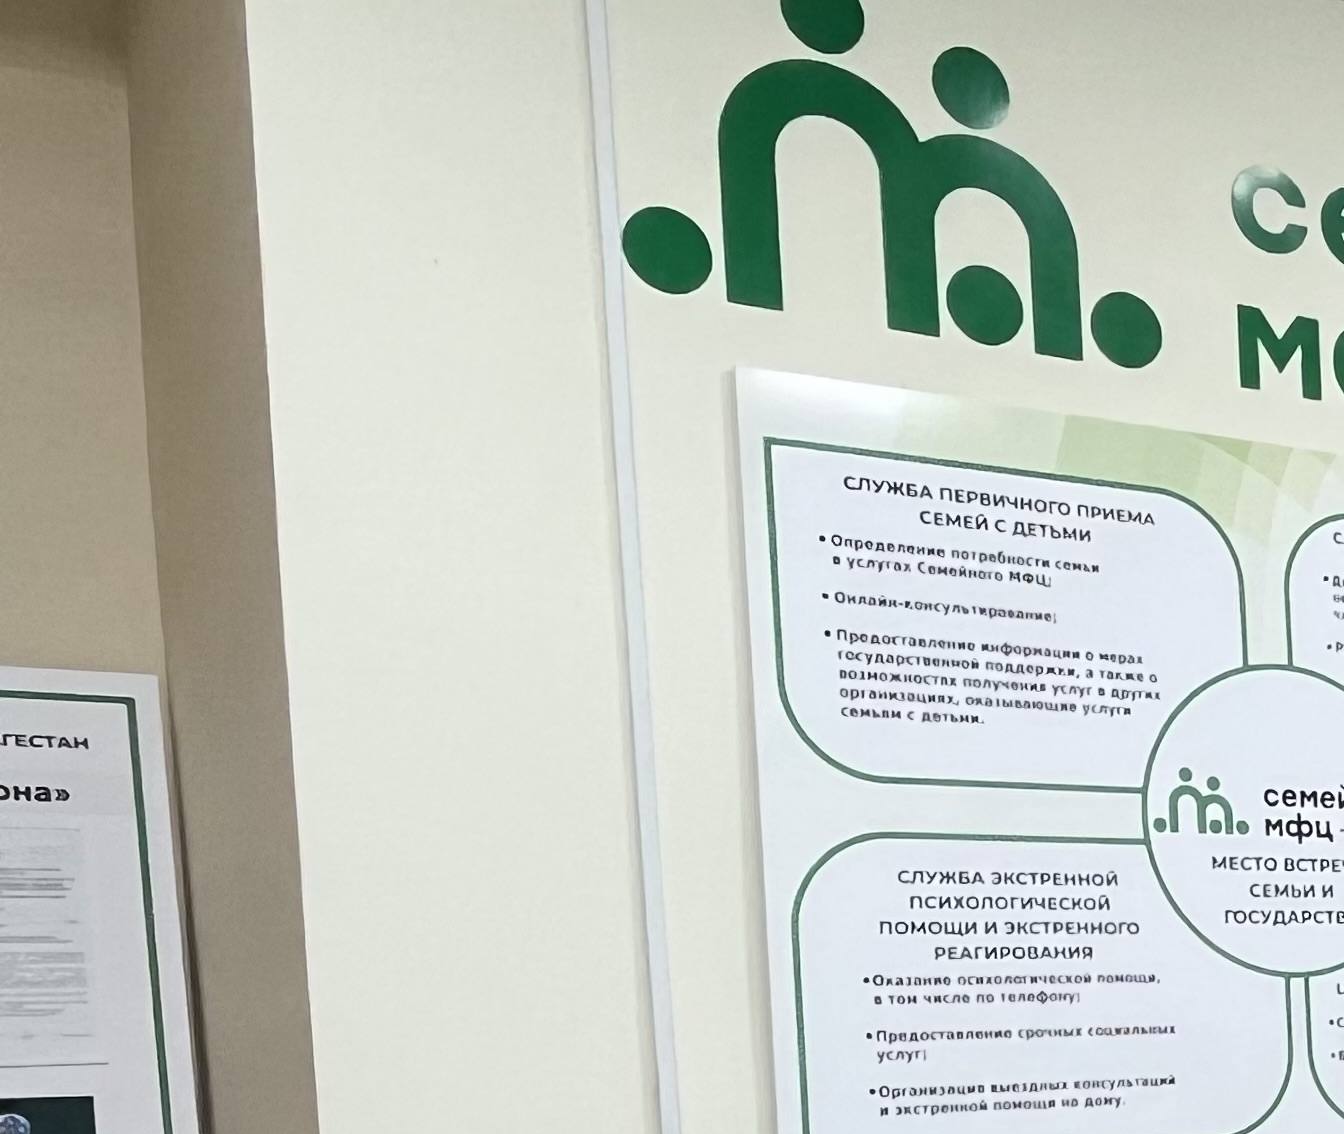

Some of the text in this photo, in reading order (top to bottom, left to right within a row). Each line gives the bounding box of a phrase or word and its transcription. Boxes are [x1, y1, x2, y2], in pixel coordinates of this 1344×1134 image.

[843, 475, 1155, 526] СЛУЖБА ПЕРВИЧНОГО ПРИЕМА
[919, 510, 1091, 543] СЕМЕЙ С ДЕТЬМИ
[830, 534, 946, 558] Определение
[951, 549, 1051, 569] потребности
[846, 556, 912, 573] услугах
[917, 561, 1004, 582] Семейного
[836, 628, 976, 652] Предоставление
[837, 650, 980, 670] государственной
[839, 669, 957, 687] возможностях
[0, 733, 89, 750] ГЕСТАН
[1264, 812, 1334, 845] мфц
[1211, 855, 1278, 872] МЕСТО
[897, 870, 1119, 887] СЛУЖБА ЭКСТРЕННОЙ
[1249, 883, 1334, 899] СЕМЬИ И
[909, 894, 1111, 911] ПСИХОЛОГИЧЕСКОЙ
[879, 920, 1140, 937] ПОМОЩИ И ЭКСТРЕННОГО
[934, 946, 1093, 961] РЕАГИРОВАНИЯ
[872, 974, 952, 987] Оказание
[876, 1029, 1013, 1045] Предоставление
